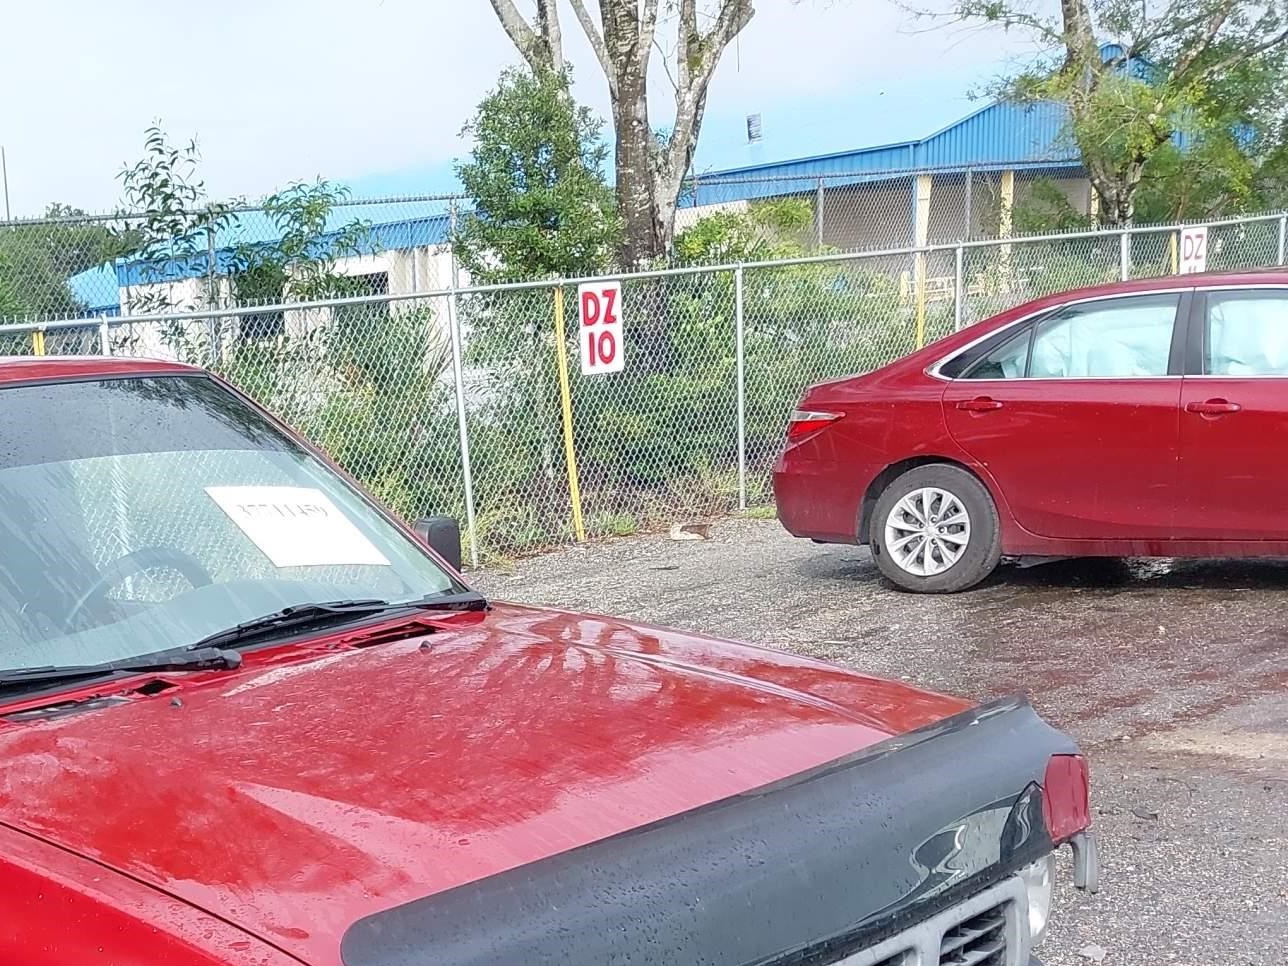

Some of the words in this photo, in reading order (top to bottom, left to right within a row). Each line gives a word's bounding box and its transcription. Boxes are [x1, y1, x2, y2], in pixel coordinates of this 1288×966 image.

[1183, 234, 1204, 261] DZ
[582, 289, 616, 326] DZ
[589, 330, 616, 366] 10
